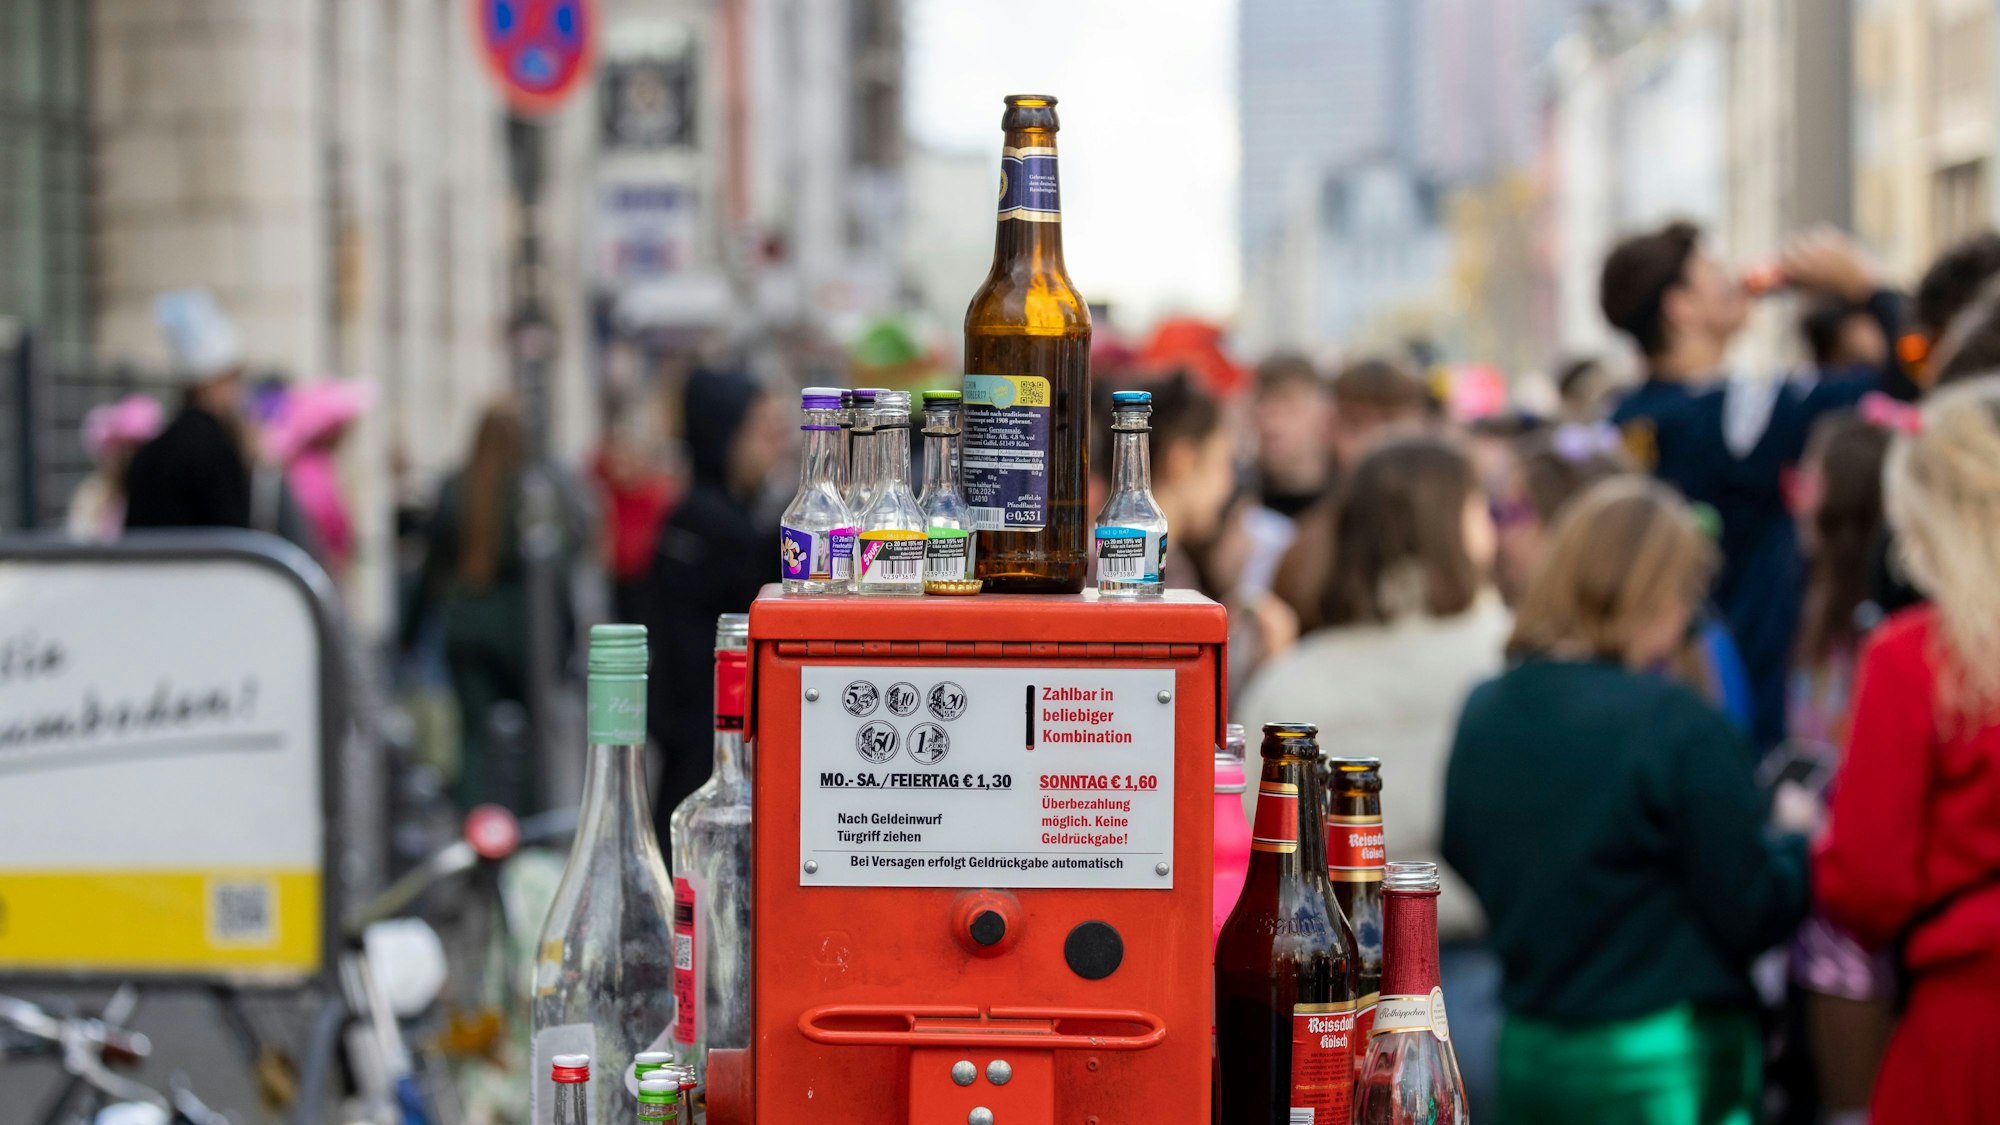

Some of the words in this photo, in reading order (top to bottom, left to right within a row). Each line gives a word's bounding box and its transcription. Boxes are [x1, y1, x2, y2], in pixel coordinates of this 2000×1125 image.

[846, 686, 860, 705] 5
[900, 692, 914, 706] 10
[944, 694, 964, 710] 20
[1042, 687, 1097, 701] Zahlbar
[1101, 687, 1114, 701] in
[1042, 708, 1114, 725] beliebiger
[871, 731, 896, 753] 50
[915, 731, 927, 753] 1
[1042, 729, 1132, 743] Kombination
[963, 774, 973, 788] €
[977, 774, 1012, 790] 1,30
[1040, 775, 1107, 789] SONNTAG
[1111, 775, 1121, 789] €
[1125, 775, 1157, 791] 1,60
[1042, 795, 1131, 812] Überbezahlung
[838, 813, 868, 824] Nach
[871, 813, 943, 825] Geldeinwurf
[1042, 816, 1092, 829] möglich.
[1095, 816, 1128, 827] Keine
[837, 830, 881, 844] Türgriff
[883, 831, 921, 842] ziehen
[1042, 833, 1128, 847] Geldrückgabe!
[850, 855, 869, 867] Bei
[872, 856, 925, 869] Versagen
[928, 857, 966, 870] erfolgt
[969, 857, 1049, 871] Geldrückgabe
[1051, 858, 1123, 869] automatisch
[1307, 1014, 1355, 1033] Reissdorf
[1320, 1033, 1348, 1048] Kölsch
